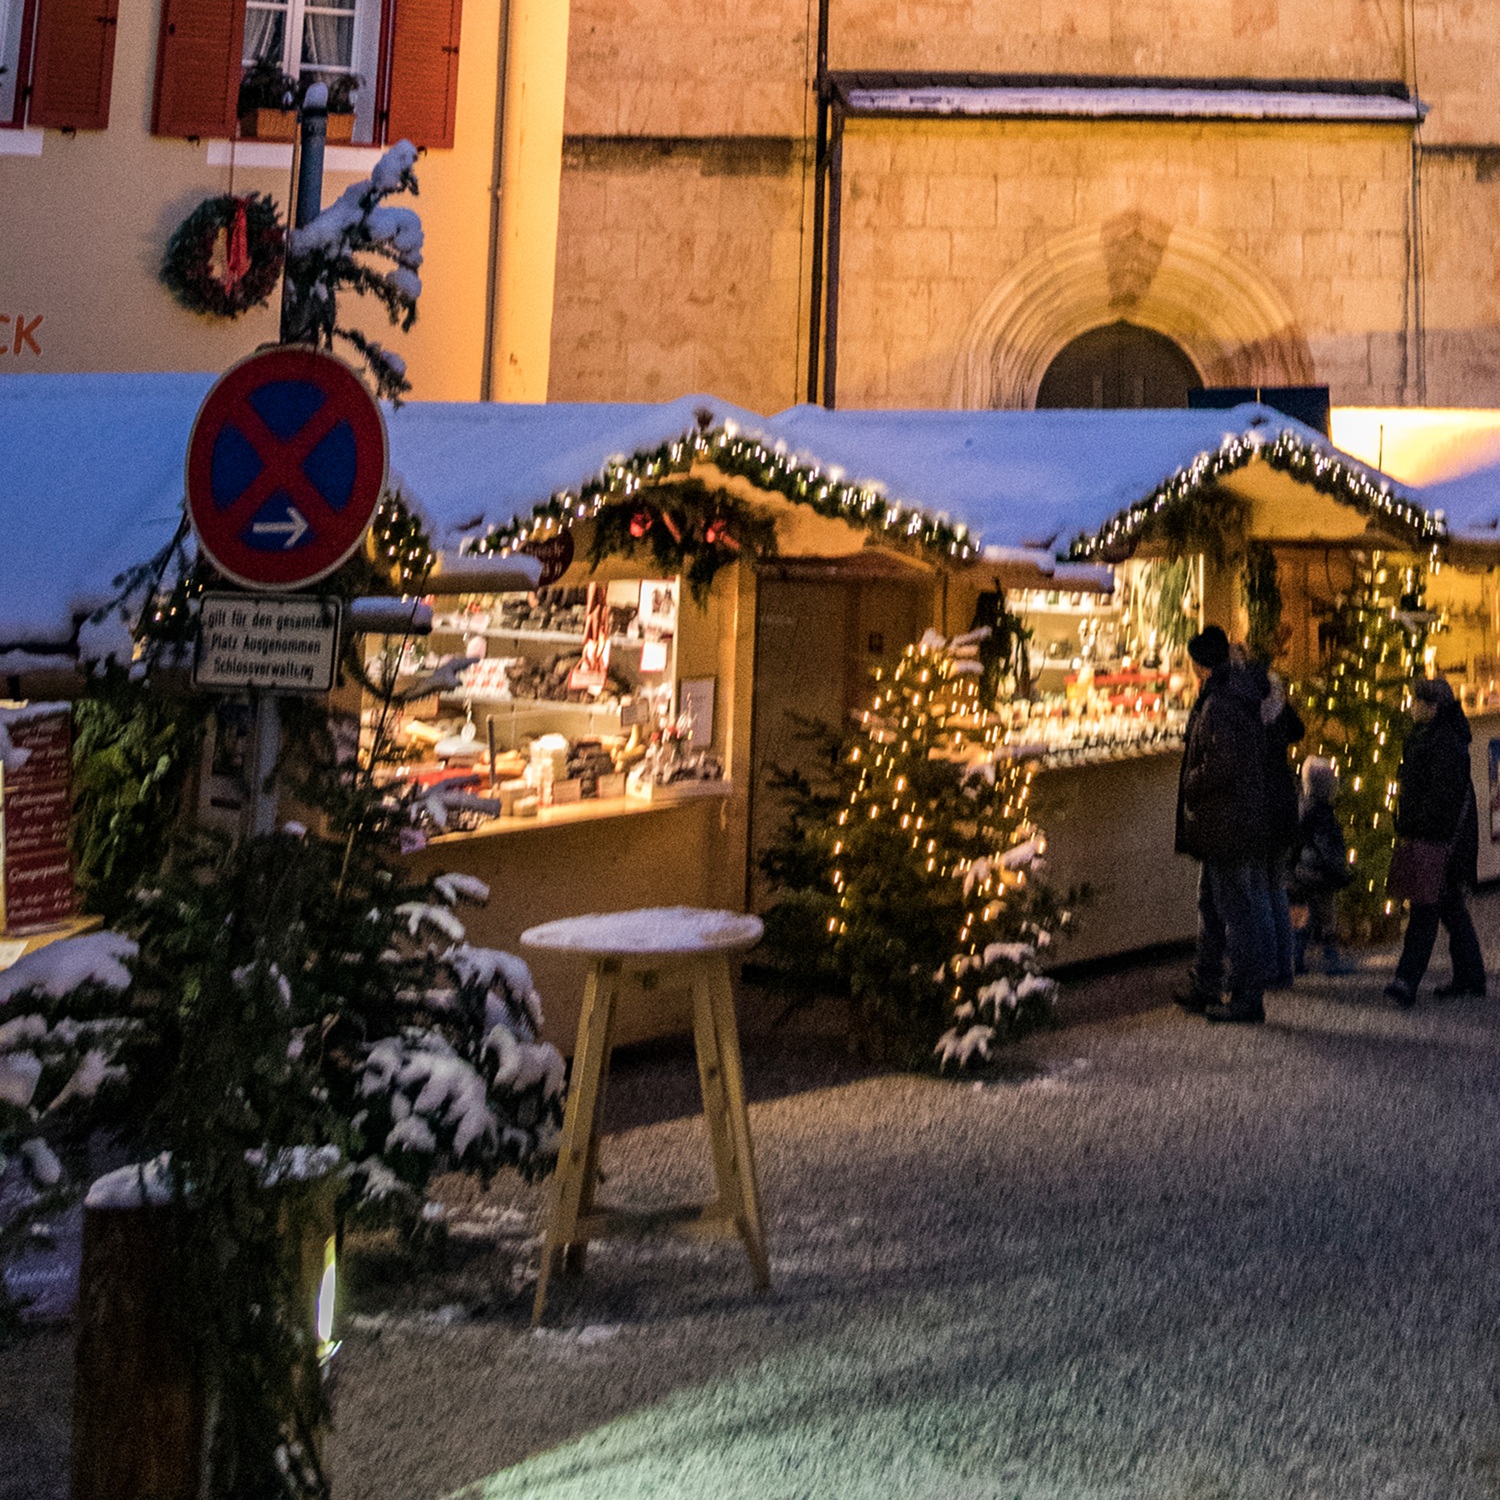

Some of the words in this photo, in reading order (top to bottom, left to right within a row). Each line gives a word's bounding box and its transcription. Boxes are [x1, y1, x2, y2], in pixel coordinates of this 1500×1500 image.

[208, 609, 227, 629] gilt
[231, 609, 247, 628] für
[252, 611, 273, 628] den
[210, 632, 238, 650] Platz
[243, 634, 321, 656] Ausgenommen
